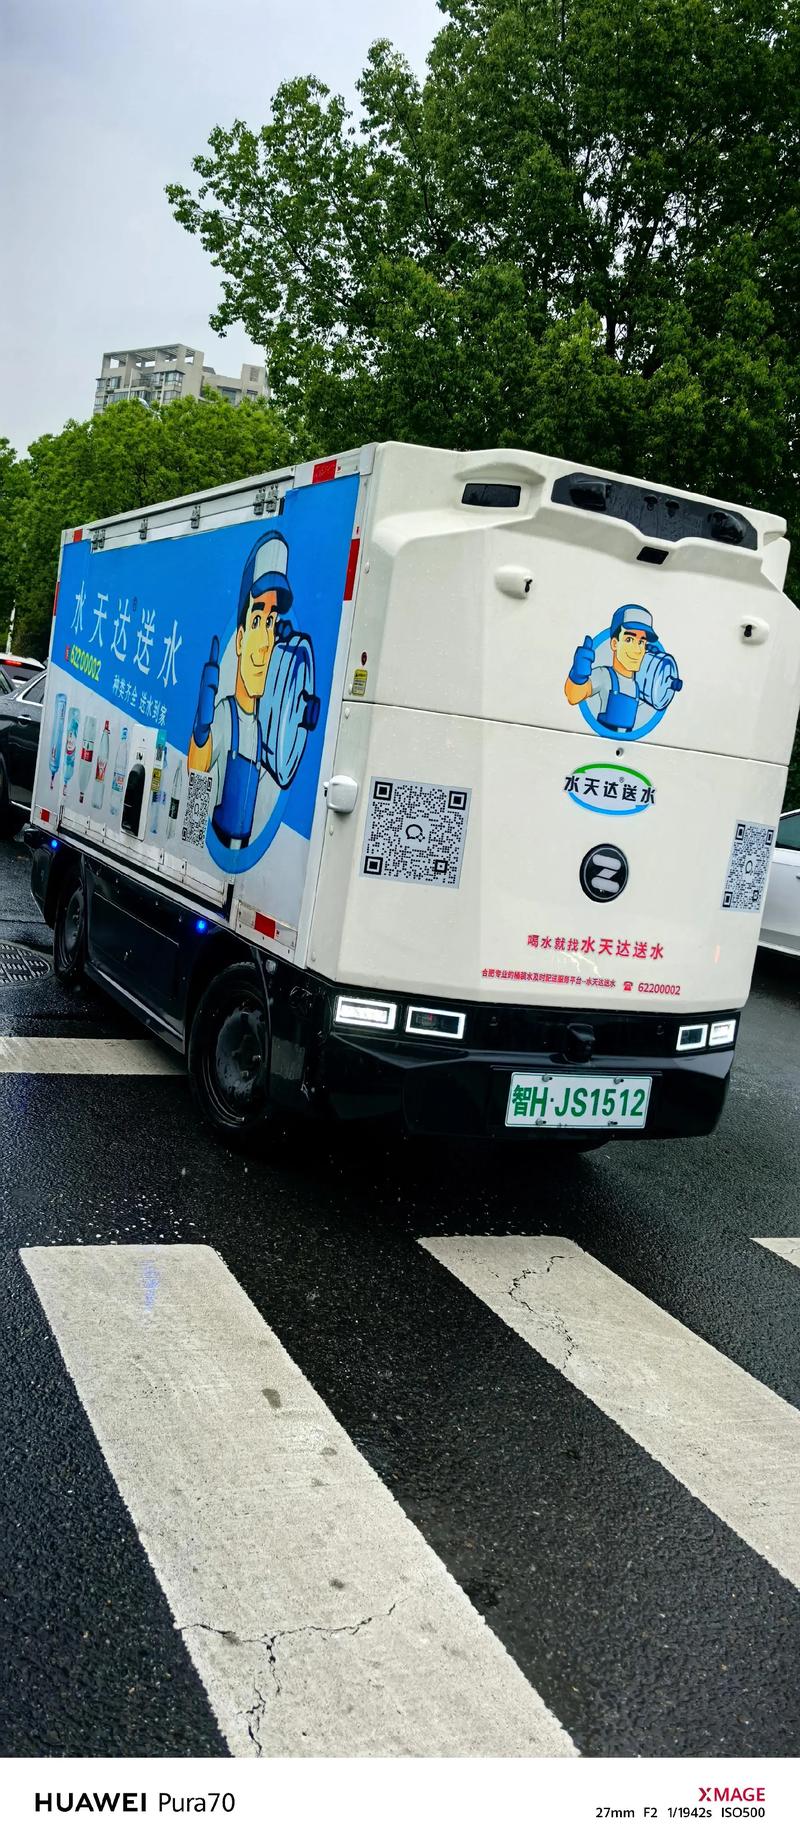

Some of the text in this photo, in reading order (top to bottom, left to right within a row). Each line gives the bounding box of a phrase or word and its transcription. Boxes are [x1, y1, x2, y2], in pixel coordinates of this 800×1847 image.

[70, 580, 183, 688] 水天达送水
[70, 644, 102, 682] 62200002
[564, 775, 656, 804] 水天达送水
[527, 934, 664, 960] 喝水就找水天达送水
[637, 982, 681, 996] 62200002
